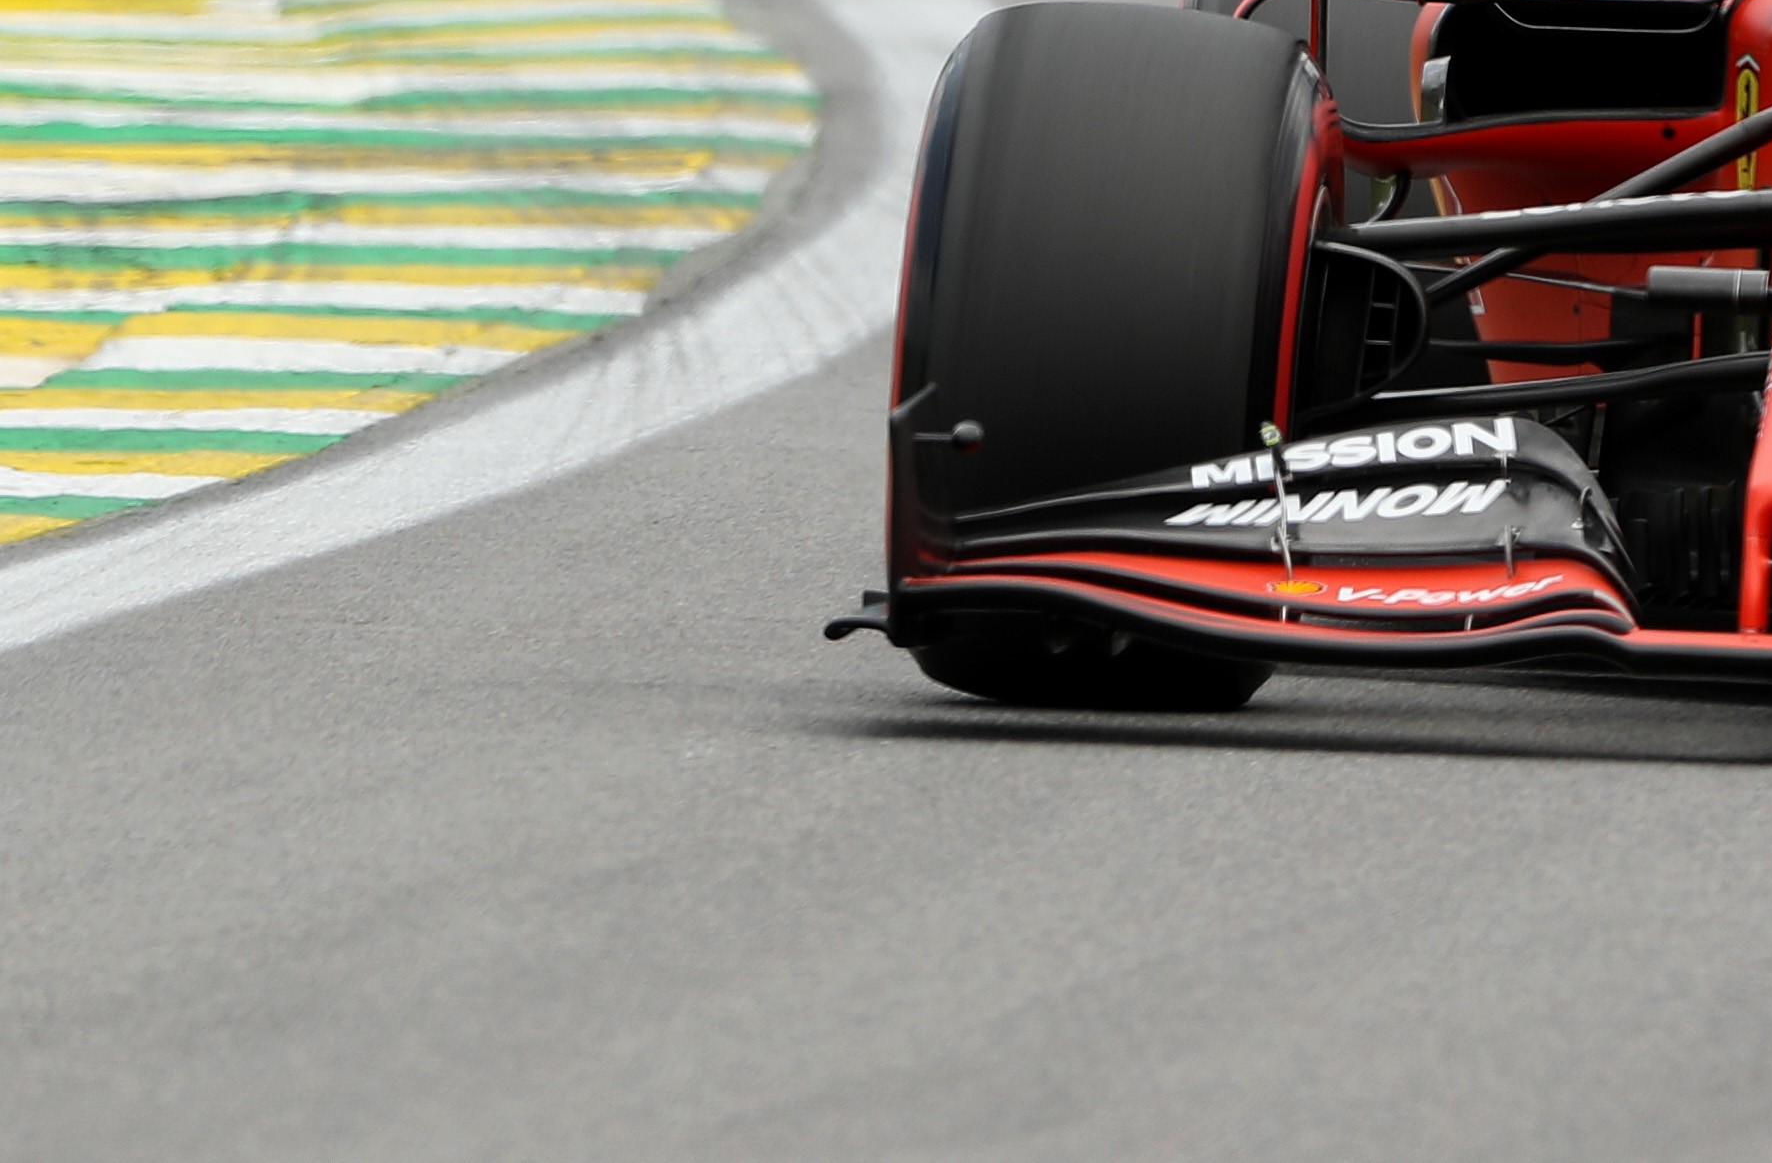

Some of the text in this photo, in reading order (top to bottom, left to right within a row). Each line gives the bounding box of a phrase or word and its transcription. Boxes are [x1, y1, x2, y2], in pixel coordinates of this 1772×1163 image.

[1191, 418, 1518, 488] MISSION
[1164, 479, 1511, 527] WINNOW
[1336, 575, 1564, 606] V-Power
